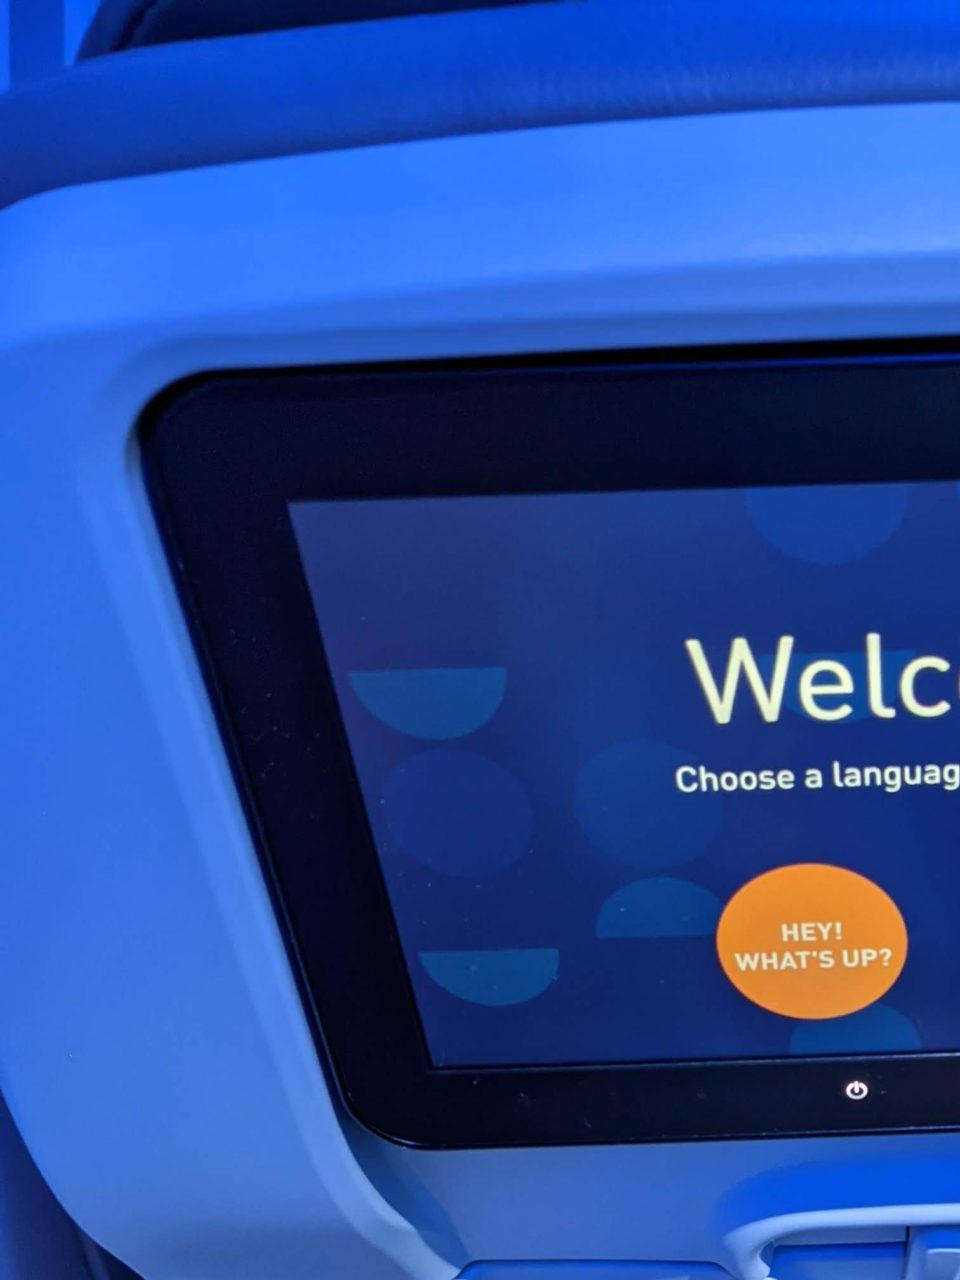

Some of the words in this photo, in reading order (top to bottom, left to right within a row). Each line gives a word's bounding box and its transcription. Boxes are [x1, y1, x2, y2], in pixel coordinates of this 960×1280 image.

[675, 765, 796, 793] Choose
[804, 768, 824, 789] a
[780, 920, 843, 942] HEY!
[734, 950, 835, 972] WHAT'S
[841, 947, 893, 969] UP?
